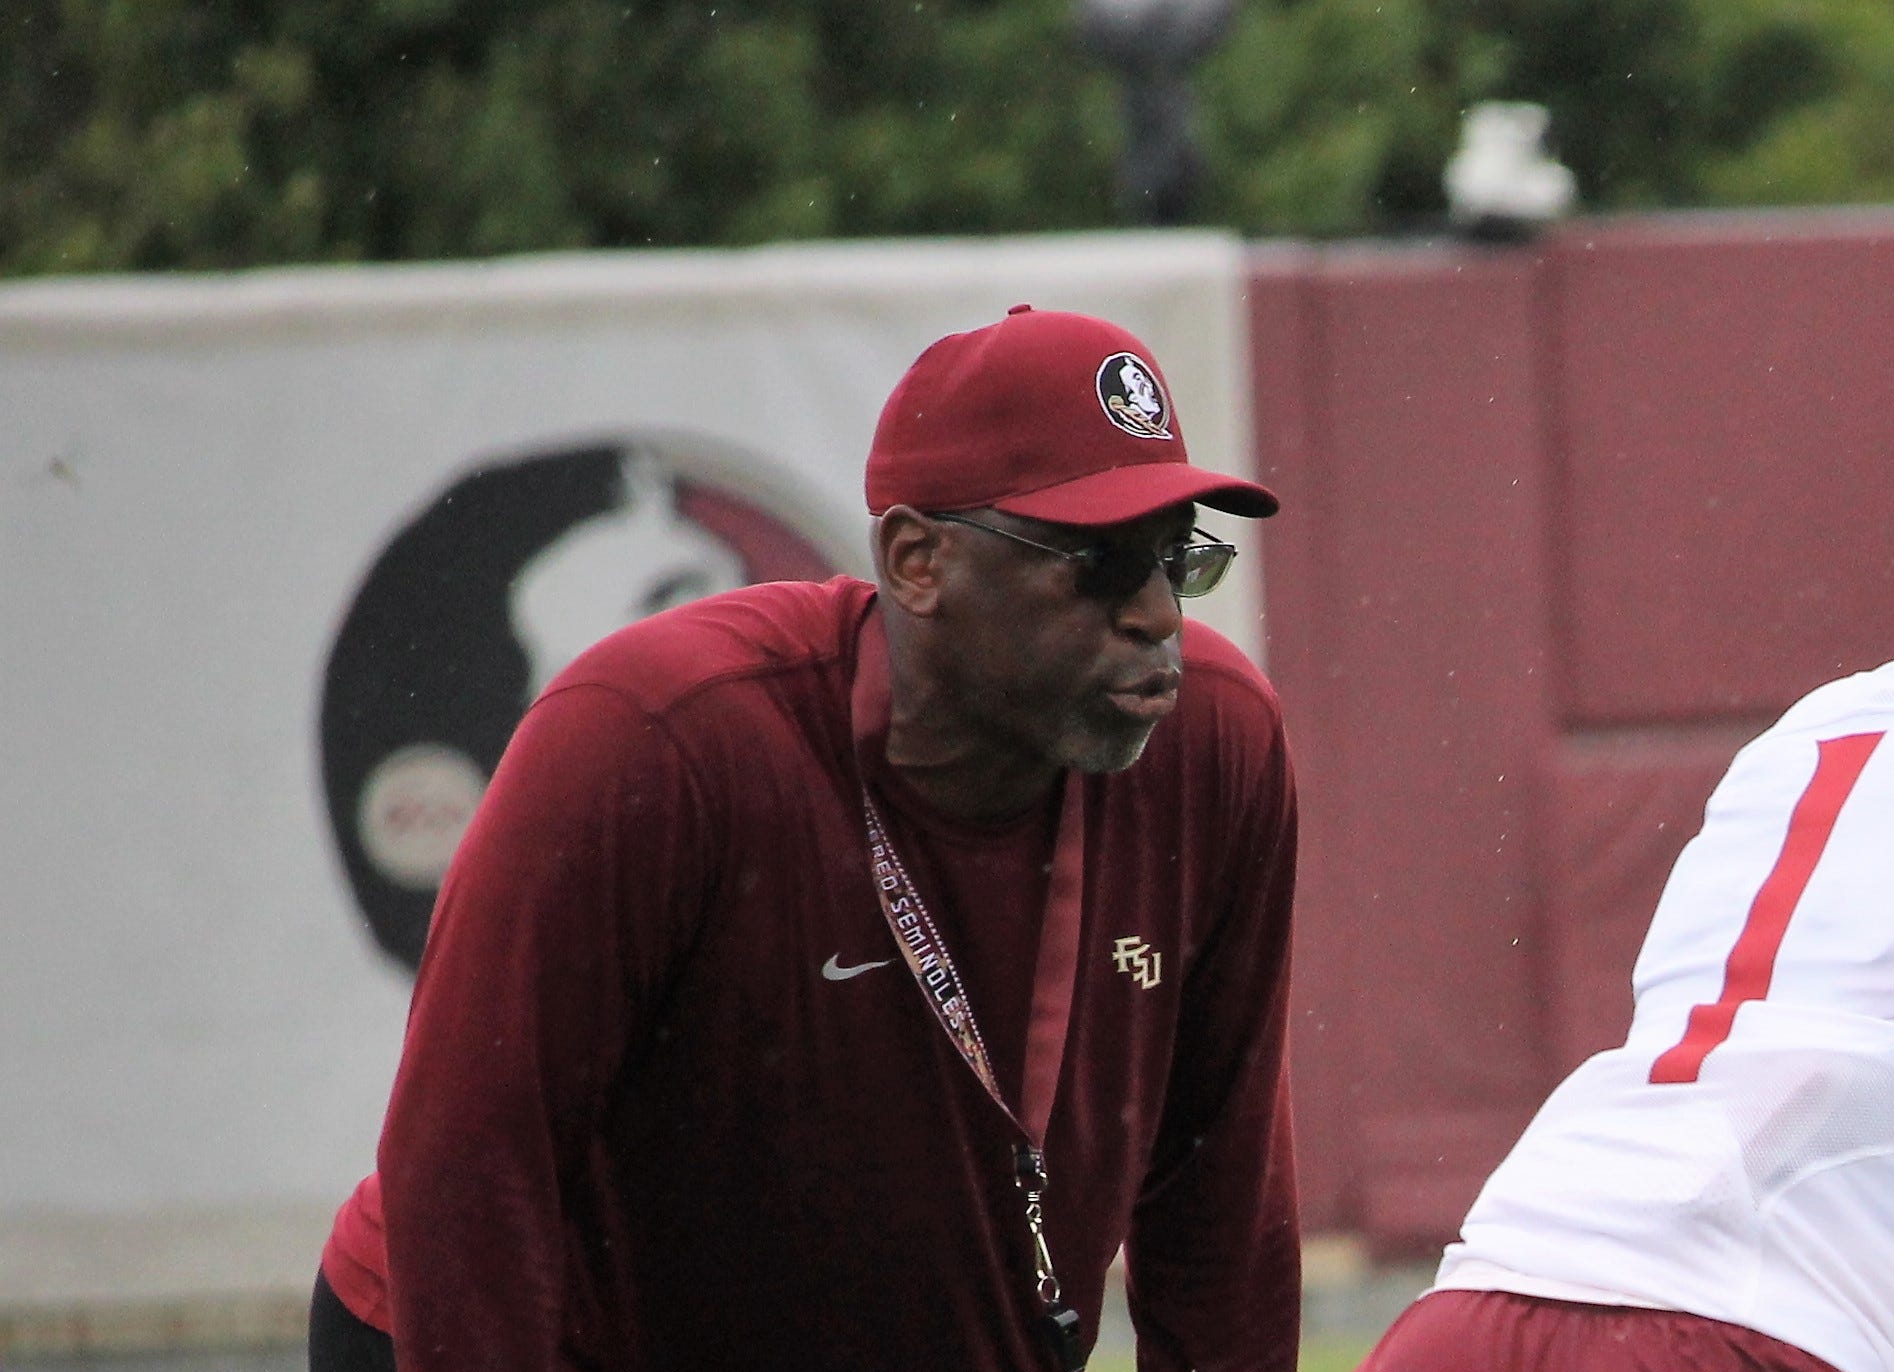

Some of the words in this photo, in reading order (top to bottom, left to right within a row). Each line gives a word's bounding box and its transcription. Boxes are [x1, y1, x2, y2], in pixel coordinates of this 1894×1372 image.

[890, 896, 965, 1030] SEMINOLES
[1111, 935, 1162, 990] FSU
[1648, 730, 1887, 1083] 1
